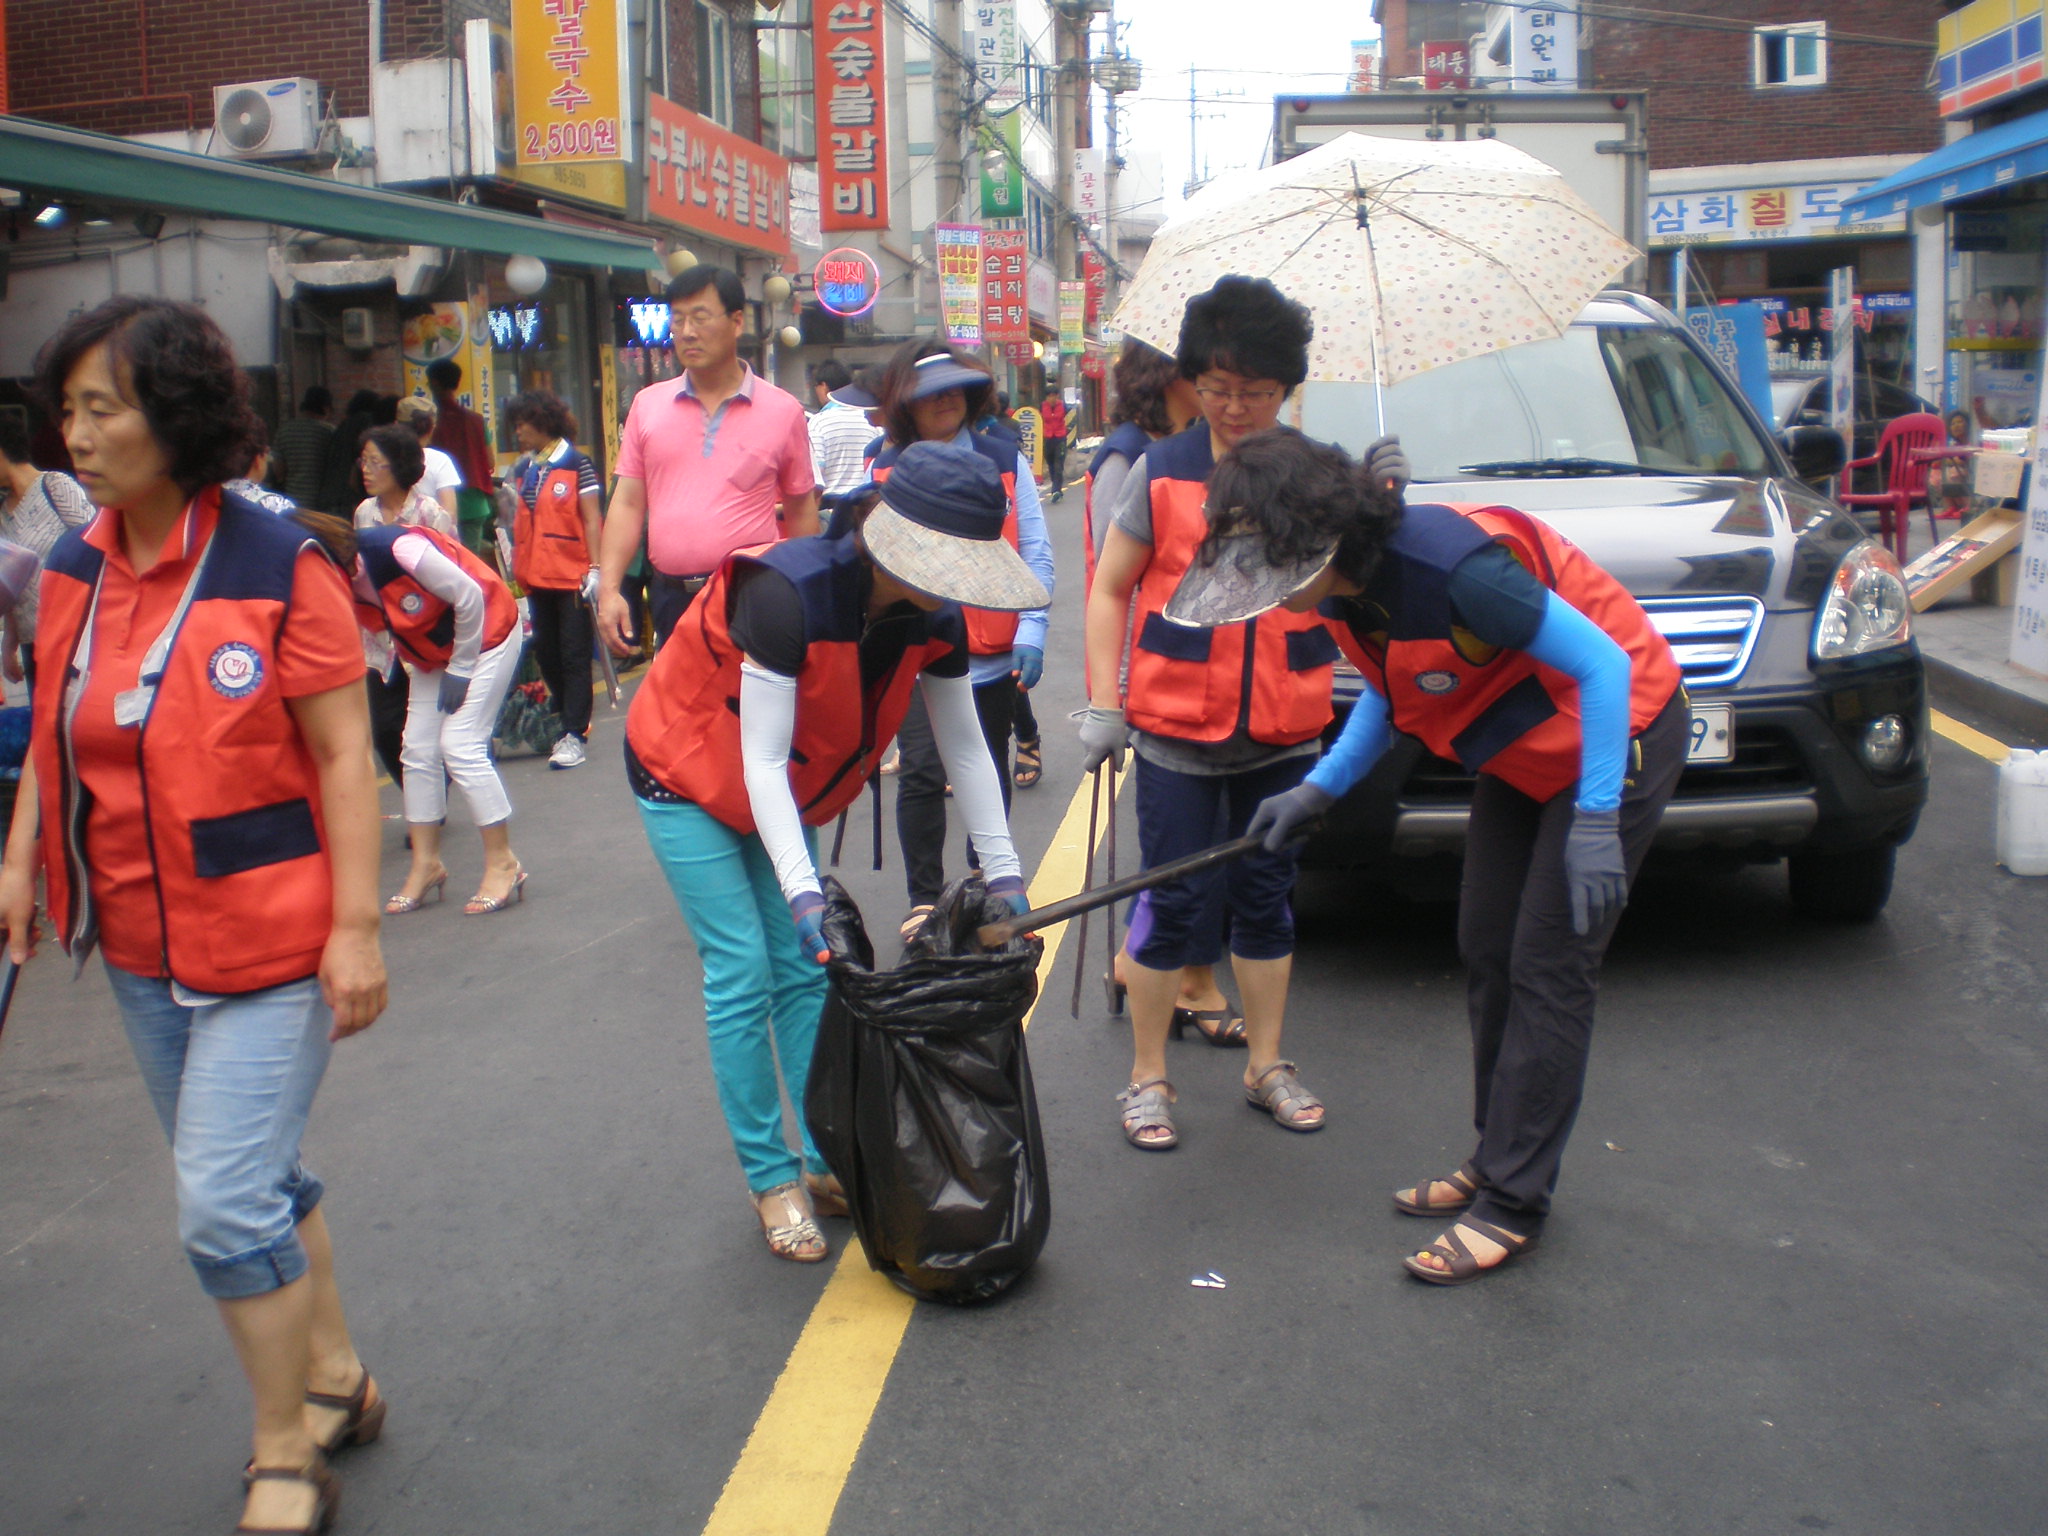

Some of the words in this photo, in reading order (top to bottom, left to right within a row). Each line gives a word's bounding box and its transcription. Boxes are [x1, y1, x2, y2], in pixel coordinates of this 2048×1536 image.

[1427, 51, 1467, 74] 태풍
[525, 117, 616, 160] 2,500원
[824, 261, 864, 282] 돼지
[986, 255, 1002, 324] 순대국
[1006, 255, 1024, 324] 감자탕
